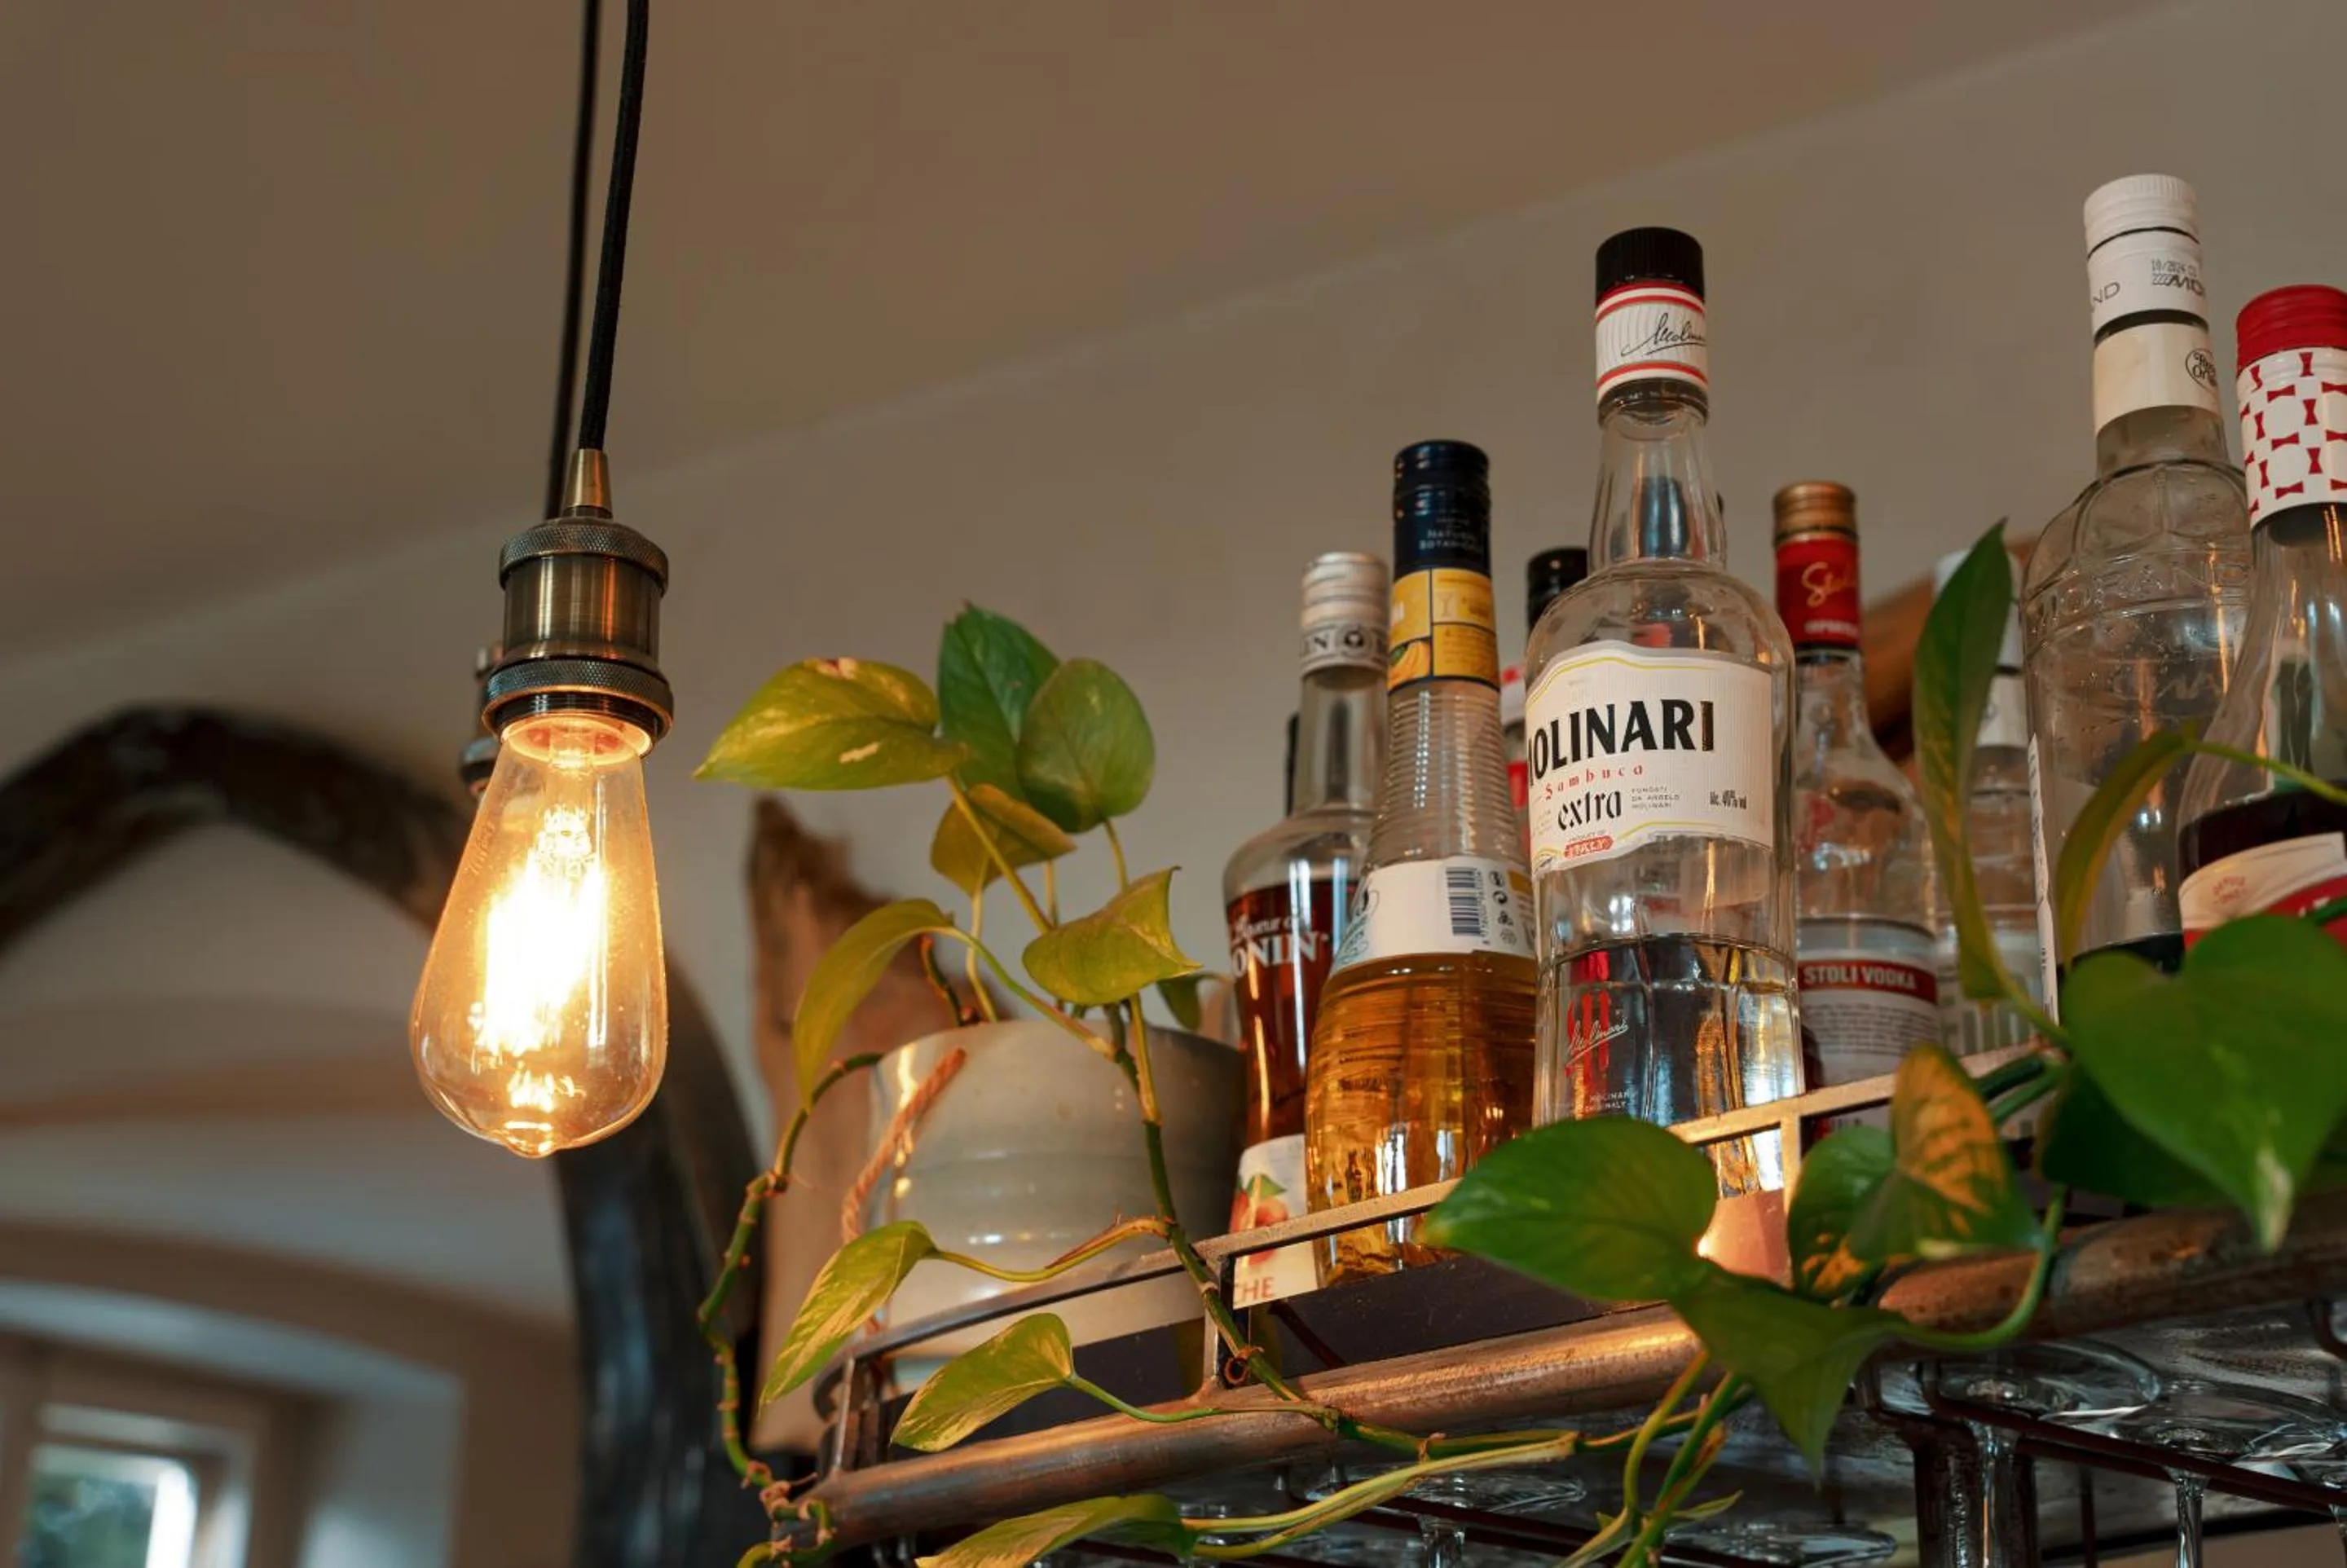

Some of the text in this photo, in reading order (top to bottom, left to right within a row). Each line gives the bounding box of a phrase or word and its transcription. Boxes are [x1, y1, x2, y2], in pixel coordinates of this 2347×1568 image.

[1528, 698, 1715, 787] OLINARI
[1545, 764, 1644, 800] Sambuca
[1557, 791, 1622, 831] extra
[1803, 966, 1917, 989] STOLI VODKA
